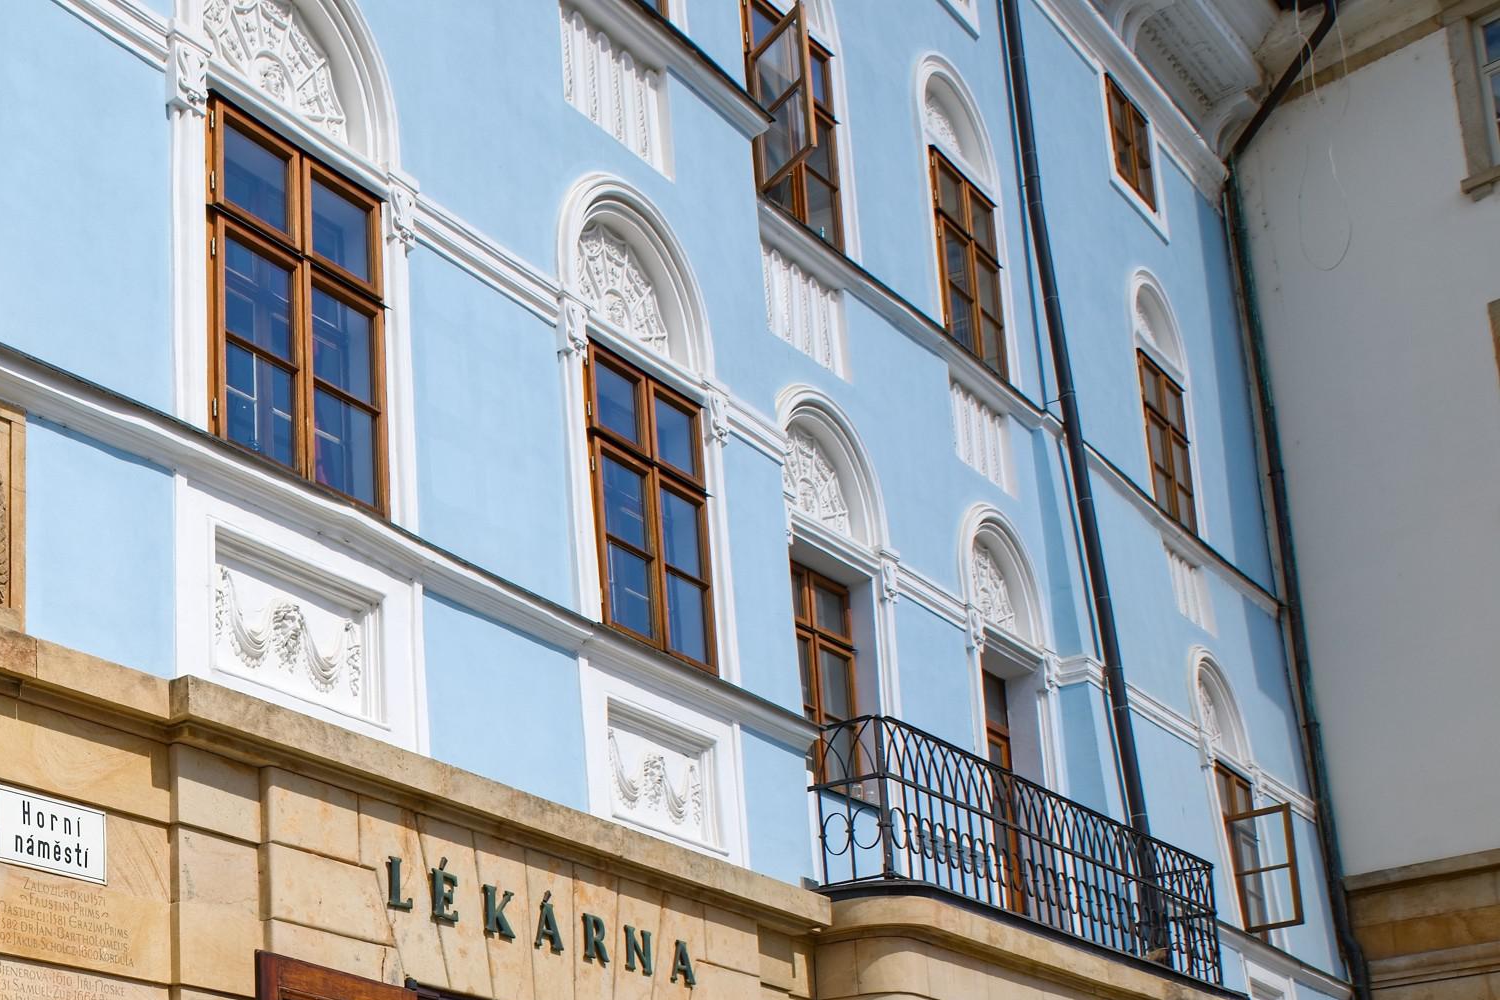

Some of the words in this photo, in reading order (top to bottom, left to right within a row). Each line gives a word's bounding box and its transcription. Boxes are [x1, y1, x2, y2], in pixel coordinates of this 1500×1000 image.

[22, 800, 80, 837] Horní
[15, 835, 88, 868] náměstí
[29, 893, 70, 912] FAUSTIN
[387, 856, 696, 986] LÉKÁRNA
